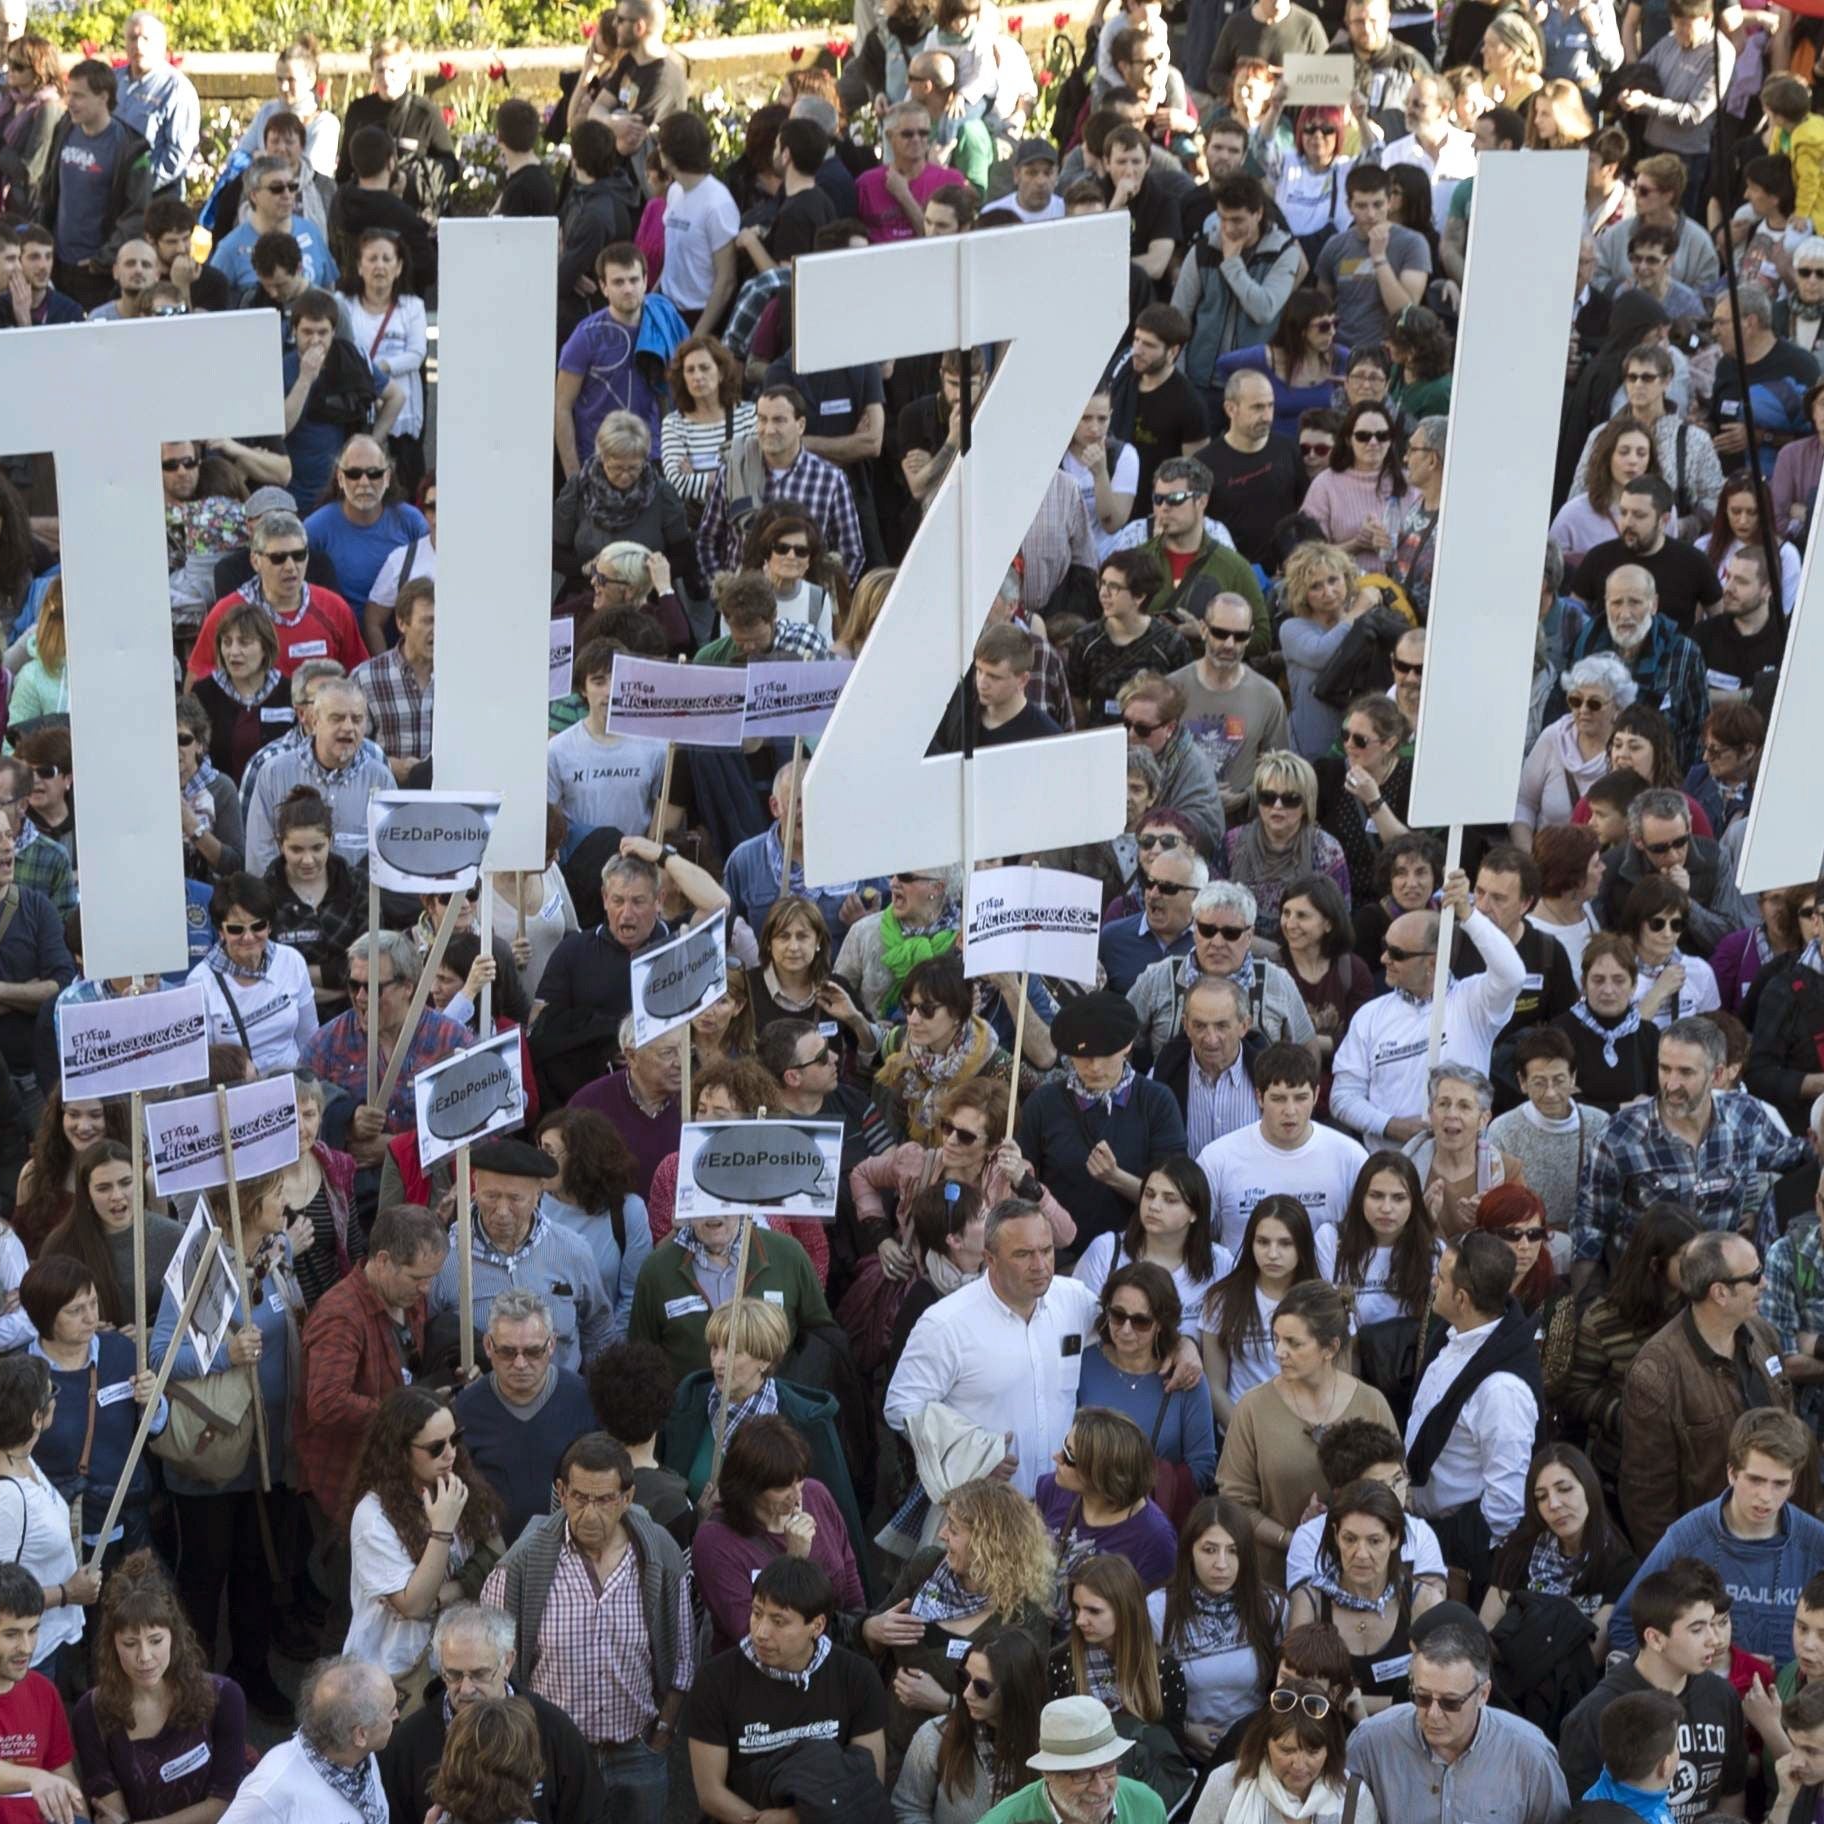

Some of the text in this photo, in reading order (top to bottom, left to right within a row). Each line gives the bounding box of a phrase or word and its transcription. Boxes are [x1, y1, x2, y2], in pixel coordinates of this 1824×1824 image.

[1296, 73, 1340, 85] JUSTIZIA
[593, 767, 641, 778] ZARAUTZ
[377, 827, 490, 843] #EzDaPosible
[645, 944, 718, 996] #EzDaPosible
[428, 1068, 509, 1116] #EzDaPosible
[697, 1151, 822, 1169] #EzDaPosible
